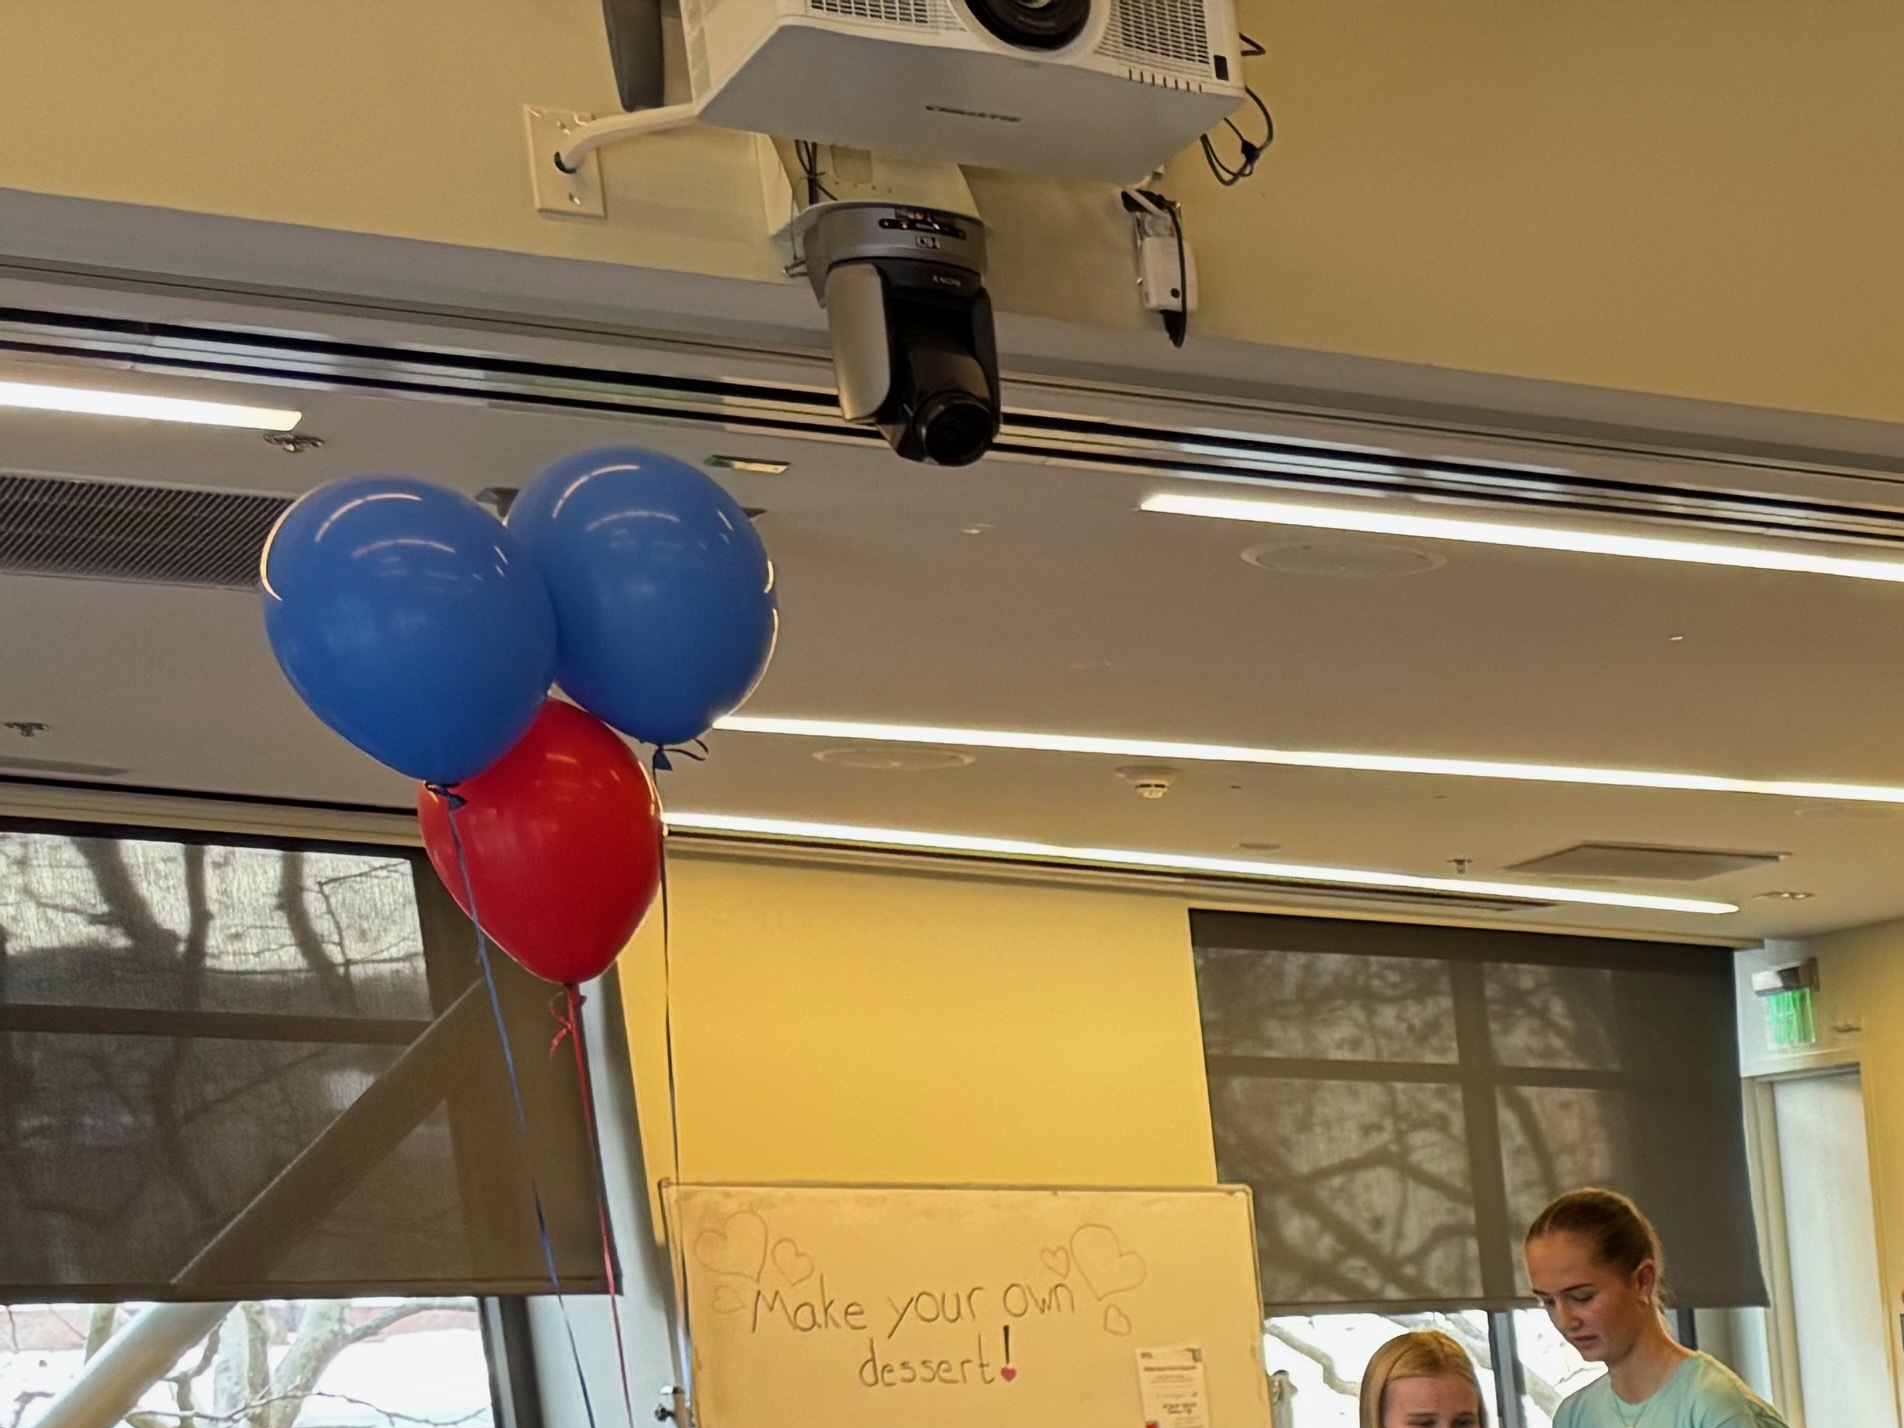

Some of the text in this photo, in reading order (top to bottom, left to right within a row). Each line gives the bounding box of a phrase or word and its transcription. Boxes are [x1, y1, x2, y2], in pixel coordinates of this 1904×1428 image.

[751, 1274, 1076, 1341] Make your own
[858, 1324, 1018, 1388] dessert!
